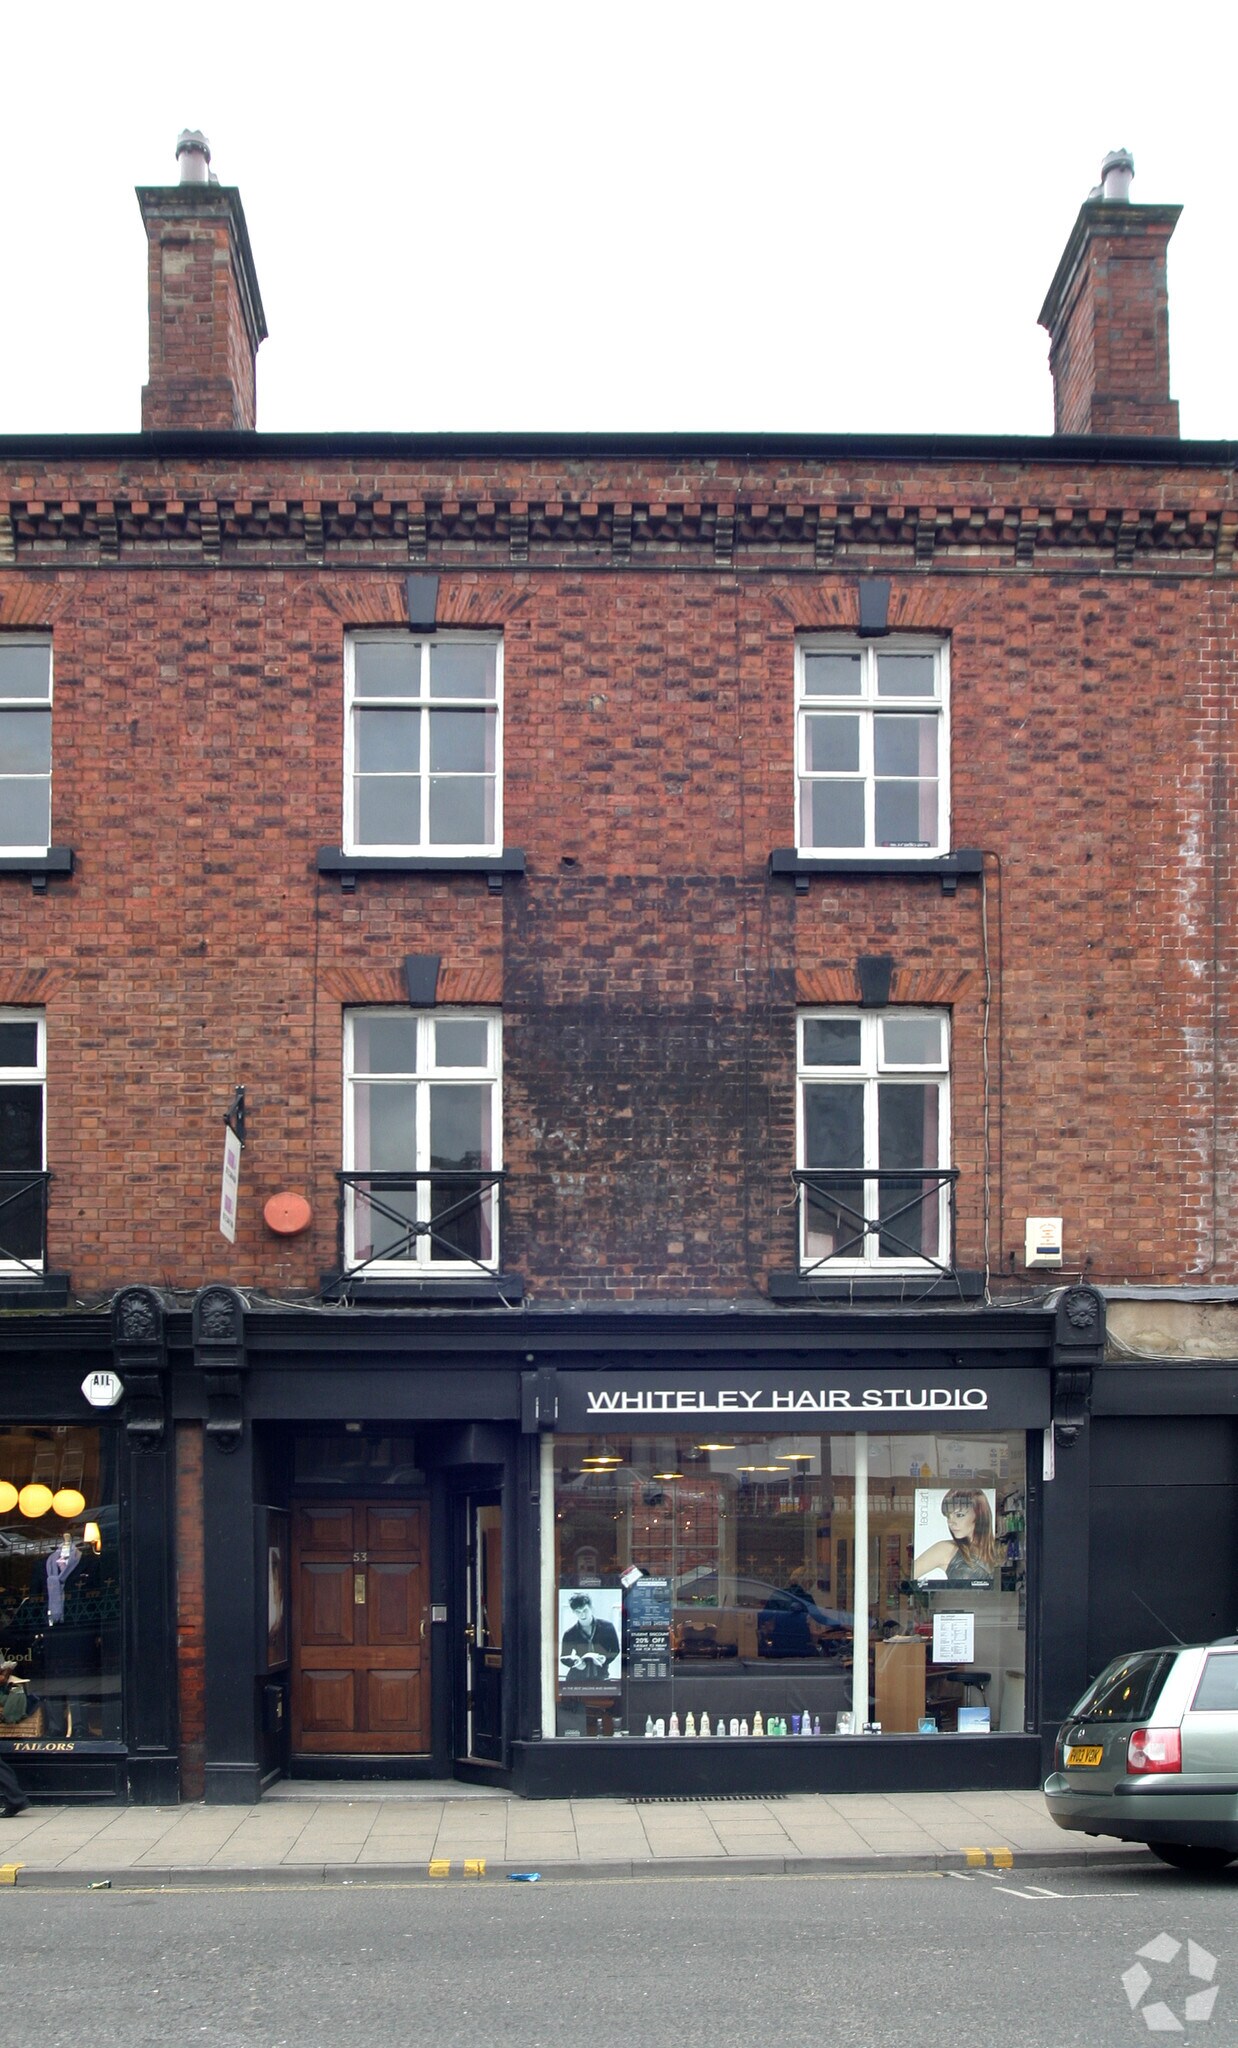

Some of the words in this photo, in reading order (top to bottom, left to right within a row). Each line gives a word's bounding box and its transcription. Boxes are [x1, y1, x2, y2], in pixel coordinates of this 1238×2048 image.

[587, 1390, 763, 1409] WHITELEY
[772, 1389, 852, 1408] HAIR
[861, 1388, 988, 1407] STUDIO
[353, 1552, 367, 1562] 53
[13, 1742, 75, 1751] TAILORS
